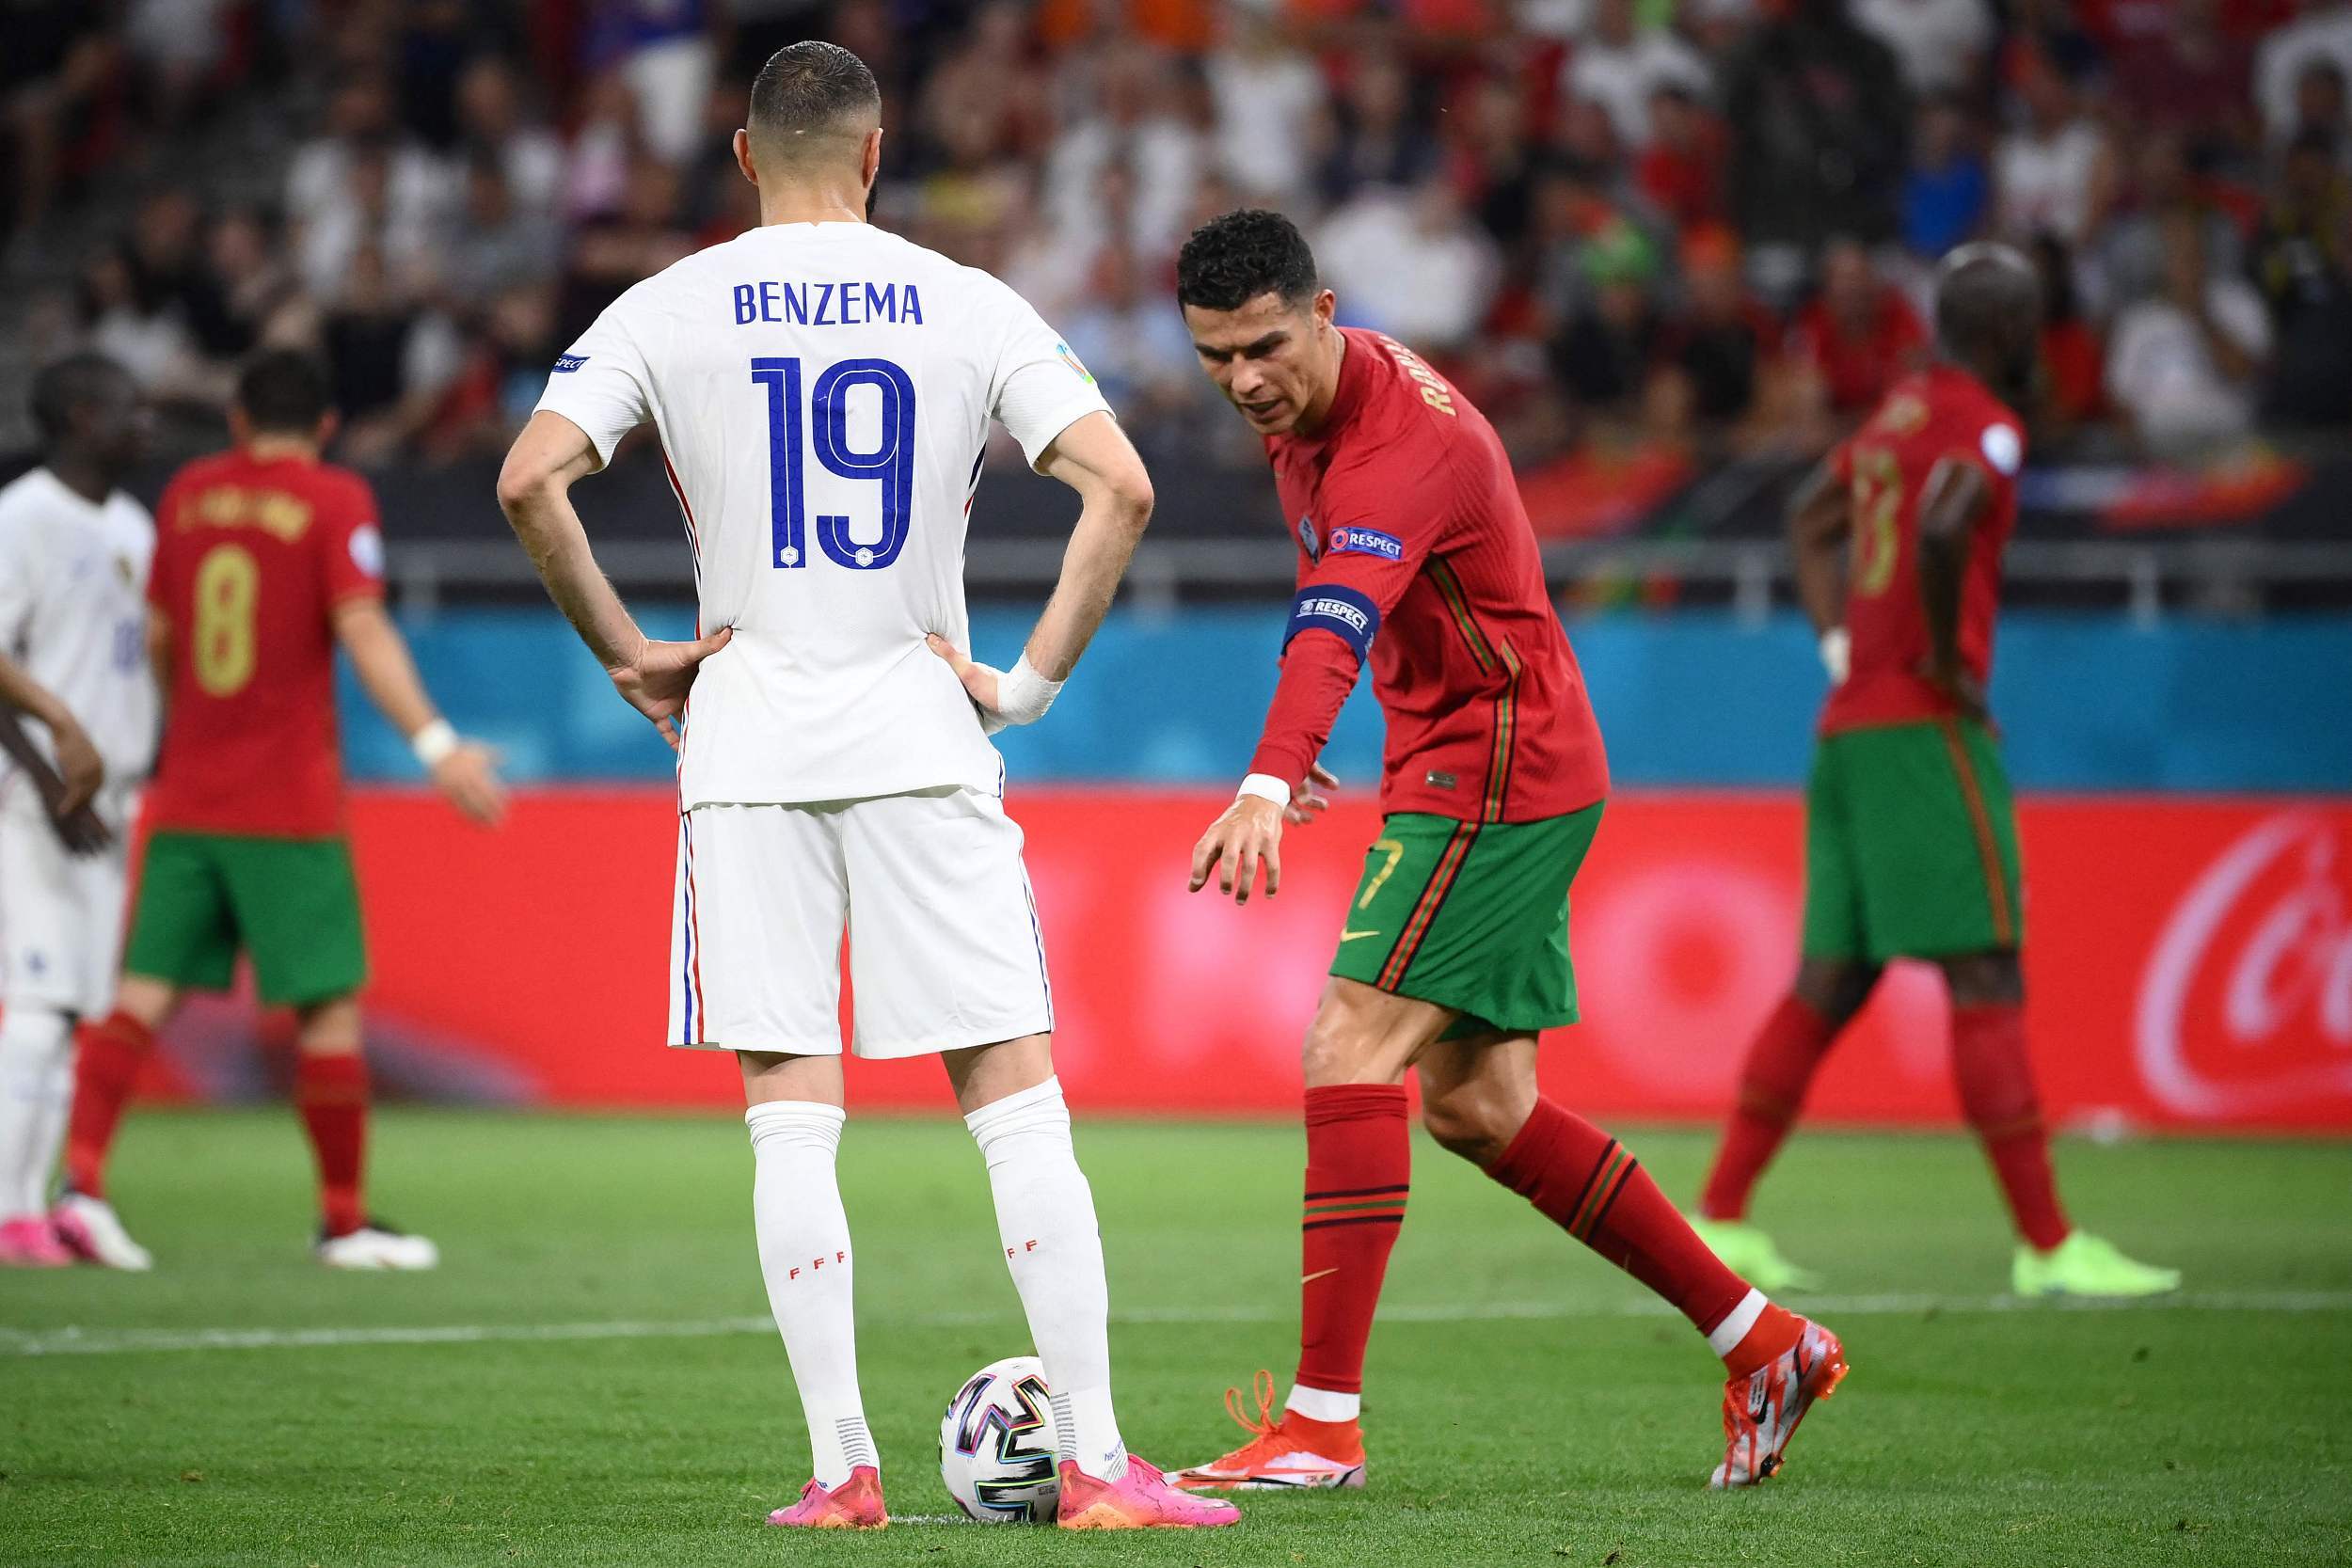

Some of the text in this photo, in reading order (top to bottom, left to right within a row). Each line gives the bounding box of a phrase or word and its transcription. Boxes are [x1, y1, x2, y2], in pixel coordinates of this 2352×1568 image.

[734, 281, 924, 326] BENZEMA
[750, 356, 916, 570] 19
[1349, 533, 1402, 557] RESPECT
[192, 538, 262, 700] 8
[1314, 600, 1369, 630] RESPECT
[1357, 839, 1404, 911] 7
